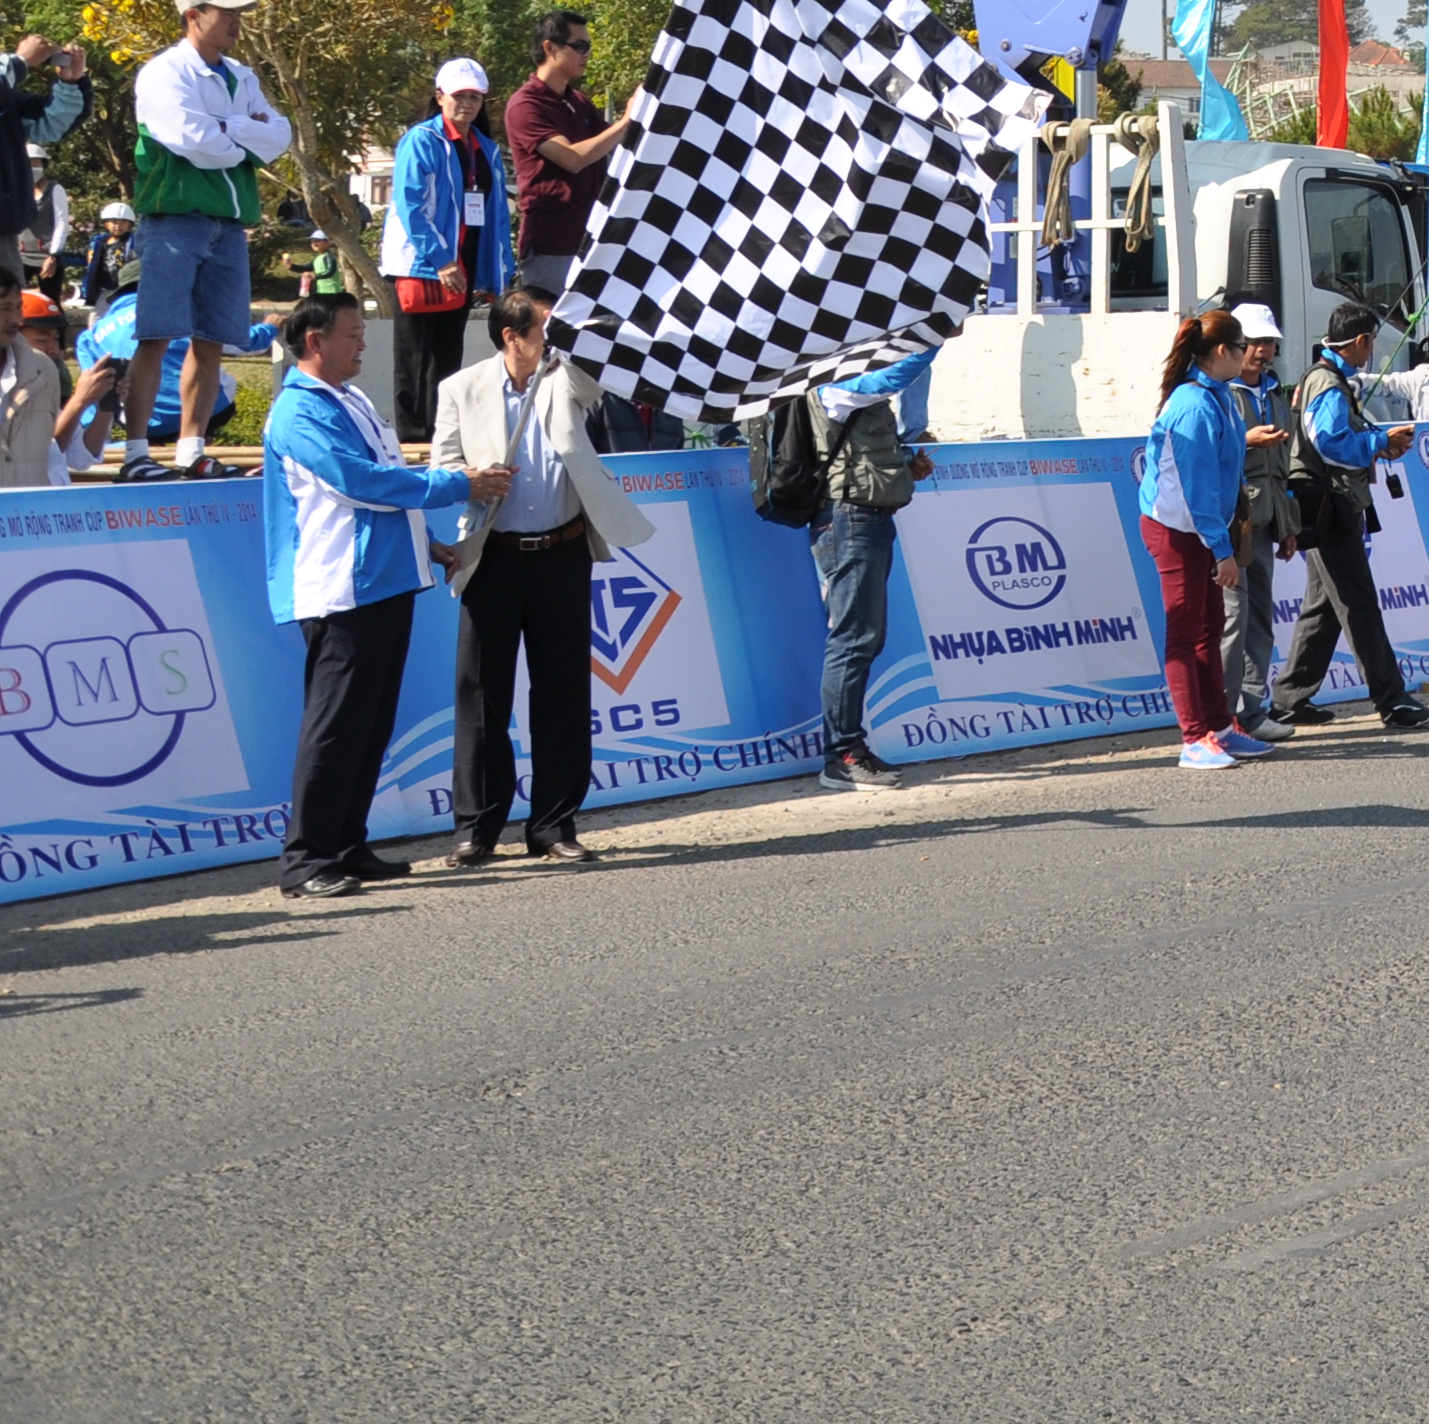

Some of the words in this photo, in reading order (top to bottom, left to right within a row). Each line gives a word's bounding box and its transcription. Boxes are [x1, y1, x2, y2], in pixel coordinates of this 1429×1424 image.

[622, 472, 685, 493] BIWASE
[1029, 458, 1079, 476] BIWASE
[9, 508, 23, 537] MỞ
[27, 510, 53, 540] RỘNG
[52, 512, 82, 532] TRANH
[87, 507, 103, 531] CÚP
[104, 506, 184, 530] BIWASE
[237, 502, 257, 522] 2014
[991, 576, 1052, 592] PLASCO
[929, 630, 1007, 665] NHỰA
[901, 707, 991, 748] ĐỒNG
[997, 702, 1051, 735] TÀI
[1055, 695, 1114, 726] TRỢ
[1121, 684, 1171, 716] CHÍ
[628, 746, 703, 782] TRỢ
[713, 730, 823, 773] CHÍNH
[0, 833, 99, 883] ỒNG
[110, 819, 195, 864] TÀI
[203, 803, 291, 849] TRỢ
